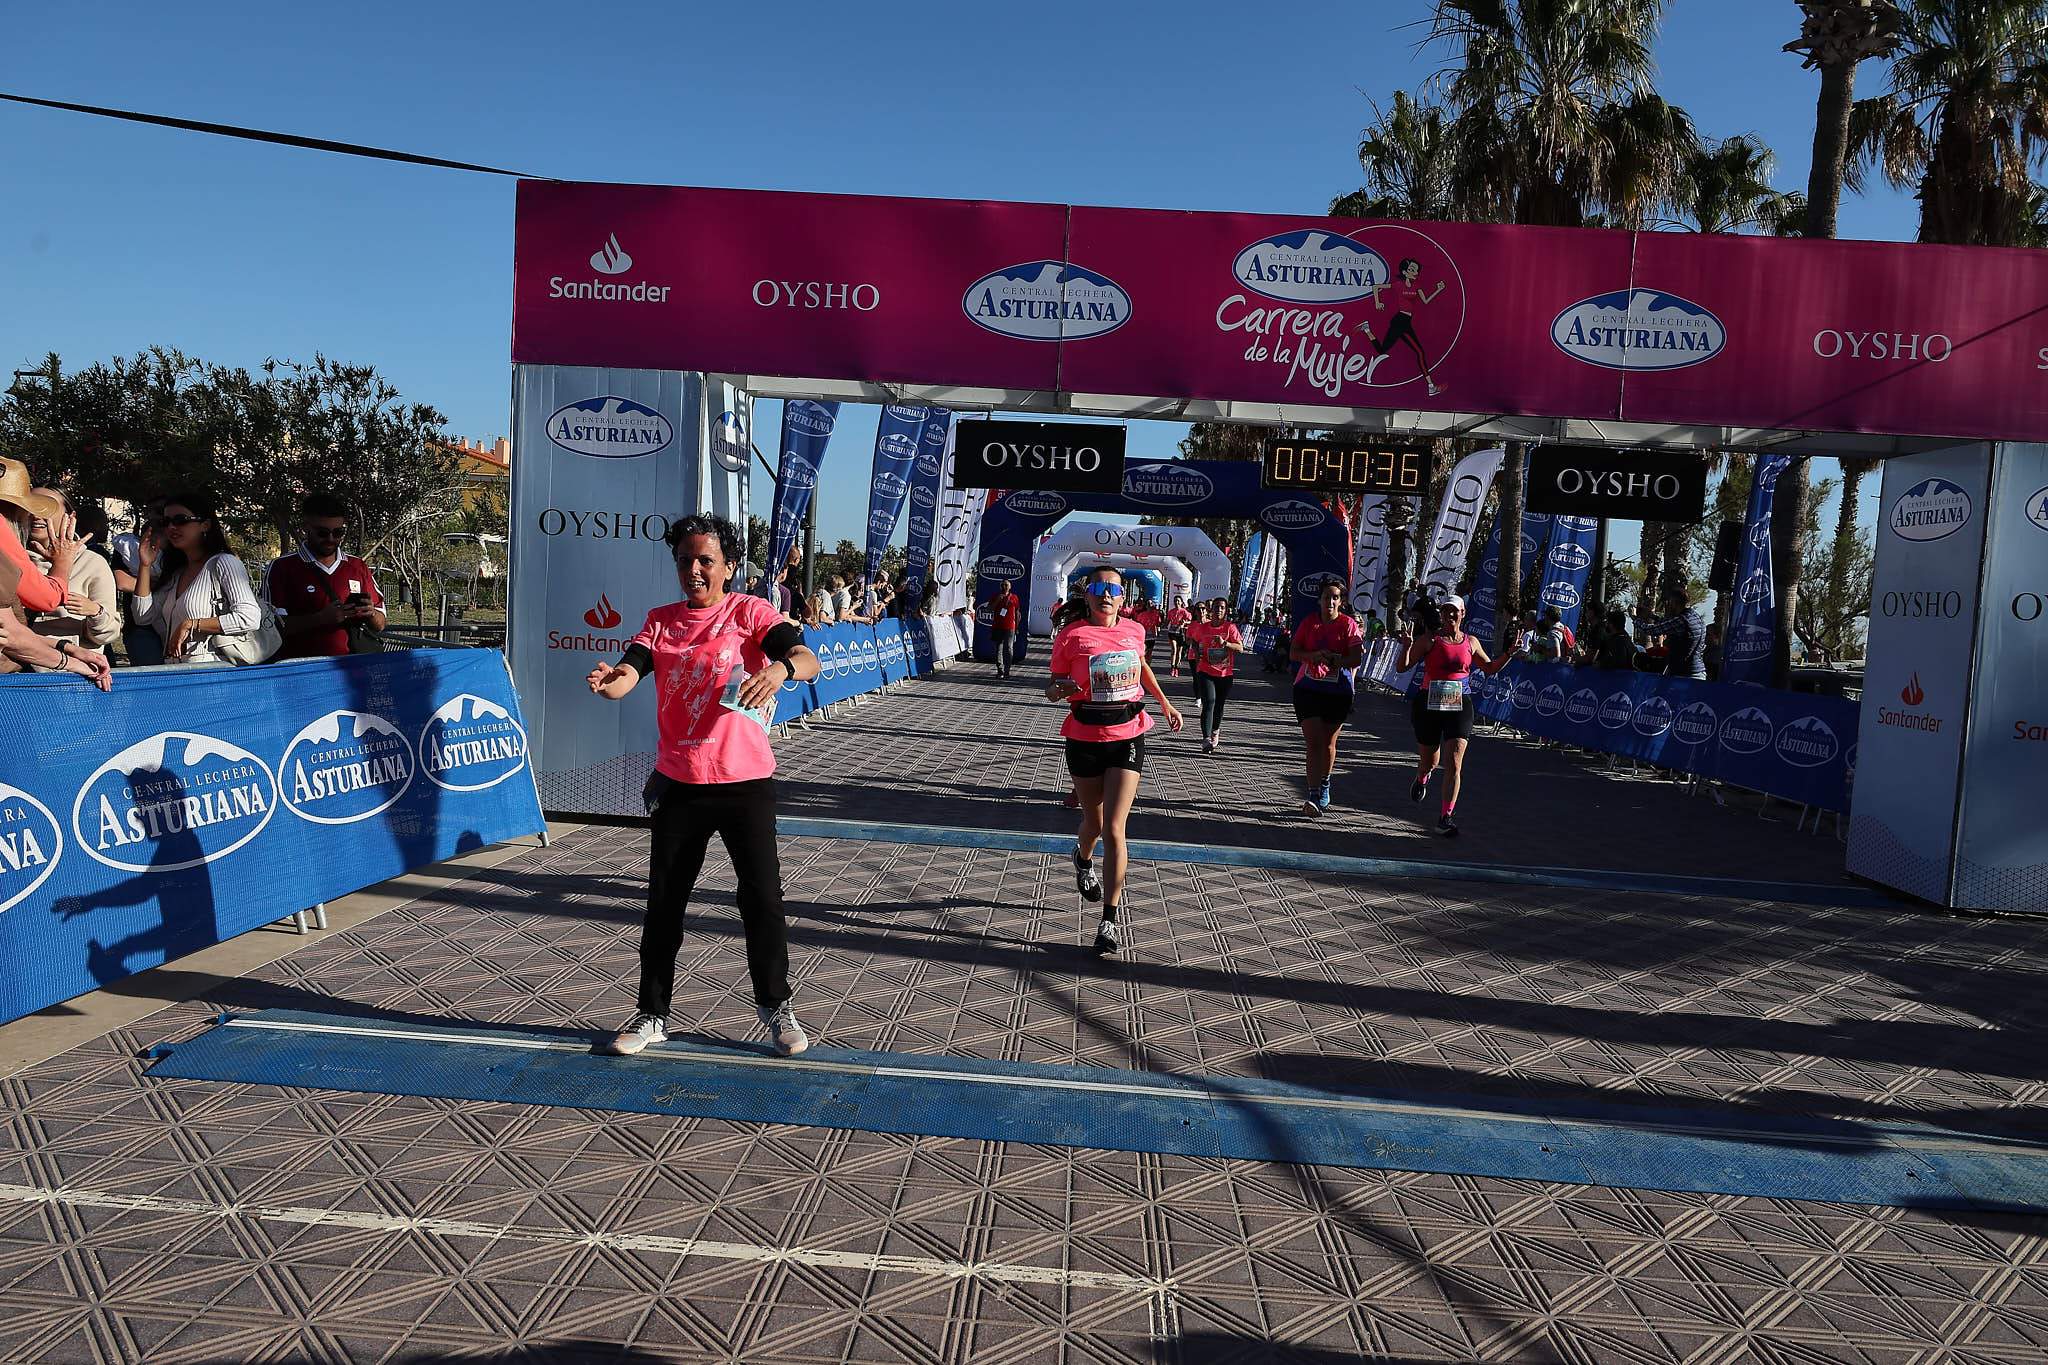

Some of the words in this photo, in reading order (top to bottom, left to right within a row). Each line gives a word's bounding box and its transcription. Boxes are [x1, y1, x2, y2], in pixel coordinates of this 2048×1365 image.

[1244, 253, 1376, 287] ASTURIANA
[1270, 253, 1318, 263] CENTRAL
[1324, 255, 1374, 266] LECHERA
[550, 276, 671, 303] Santander
[752, 279, 881, 311] OYSHO
[1002, 286, 1055, 297] CENTRAL
[1060, 287, 1114, 299] LECHERA
[975, 287, 1119, 322] ASTURIANA
[1216, 294, 1343, 338] Carrera
[1563, 315, 1712, 351] ASTURIANA
[1592, 314, 1649, 325] CENTRAL
[1651, 317, 1708, 328] LECHERA
[1813, 329, 1952, 362] OYSHO
[1244, 335, 1268, 363] de
[1273, 336, 1291, 364] la
[1284, 336, 1390, 398] Mujer
[555, 416, 664, 445] ASTURIANA
[575, 416, 616, 425] CENTRAL
[981, 442, 1101, 472] OYSHO
[1275, 447, 1420, 487] 00:40:36
[1123, 474, 1206, 497] ASTURIANA
[1556, 468, 1681, 501] OYSHO
[1009, 496, 1061, 510] ASTURIANA
[1266, 510, 1321, 523] ASTURIANA
[1894, 505, 1965, 528] ASTURIANA
[538, 508, 670, 542] OYSHO
[1095, 528, 1173, 549] OYSHO
[1882, 591, 1962, 619] OYSHO
[441, 726, 475, 740] CENTRAL
[1877, 706, 1943, 734] Santander
[310, 747, 355, 765] CENTRAL
[358, 738, 401, 755] LECHERA
[430, 734, 522, 773] ASTURIANA
[1779, 735, 1831, 760] ASTURIANA
[122, 777, 189, 800] CENTRAL
[195, 765, 256, 786] LECHERA
[293, 753, 408, 805] ASTURIANA
[97, 782, 268, 851] ASTURIANA
